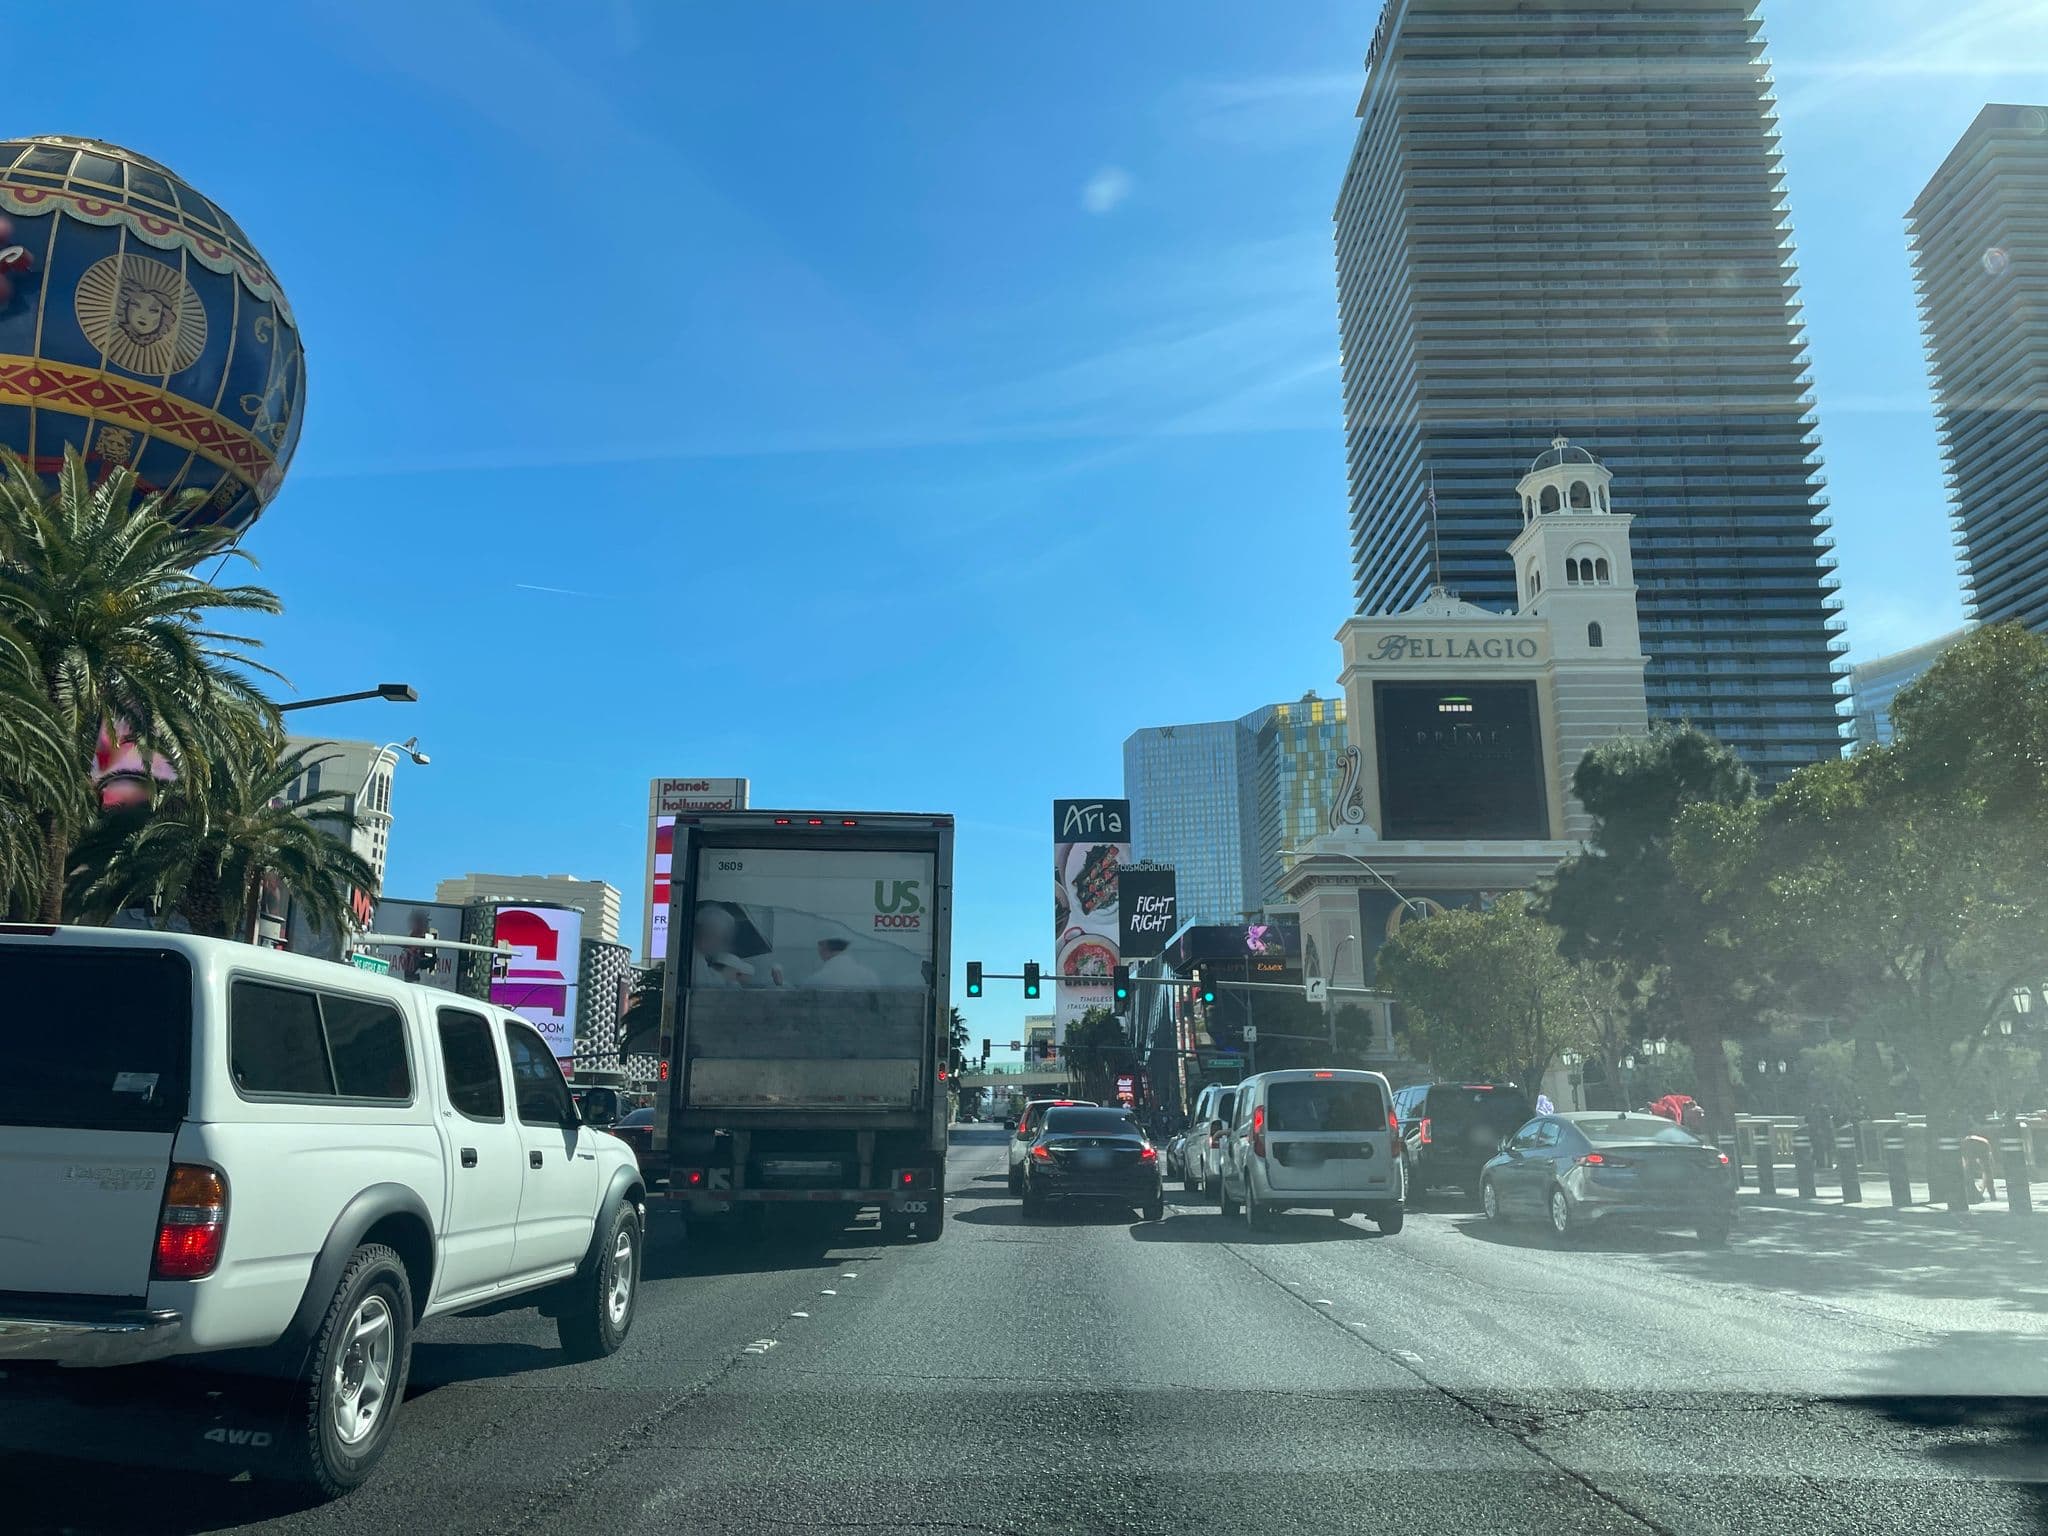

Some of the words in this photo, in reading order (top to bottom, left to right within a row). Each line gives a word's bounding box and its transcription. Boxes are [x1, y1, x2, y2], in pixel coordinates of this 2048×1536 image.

[1367, 634, 1538, 661] BELLAGIO
[663, 779, 710, 795] planet
[1063, 804, 1122, 836] Aria
[718, 861, 744, 871] 3609
[1120, 863, 1175, 872] COSMOPOLITAN
[1136, 896, 1175, 913] FIGHT
[874, 914, 920, 928] FOODS
[1130, 914, 1172, 933] RIGHT
[203, 1428, 272, 1447] 4WD
